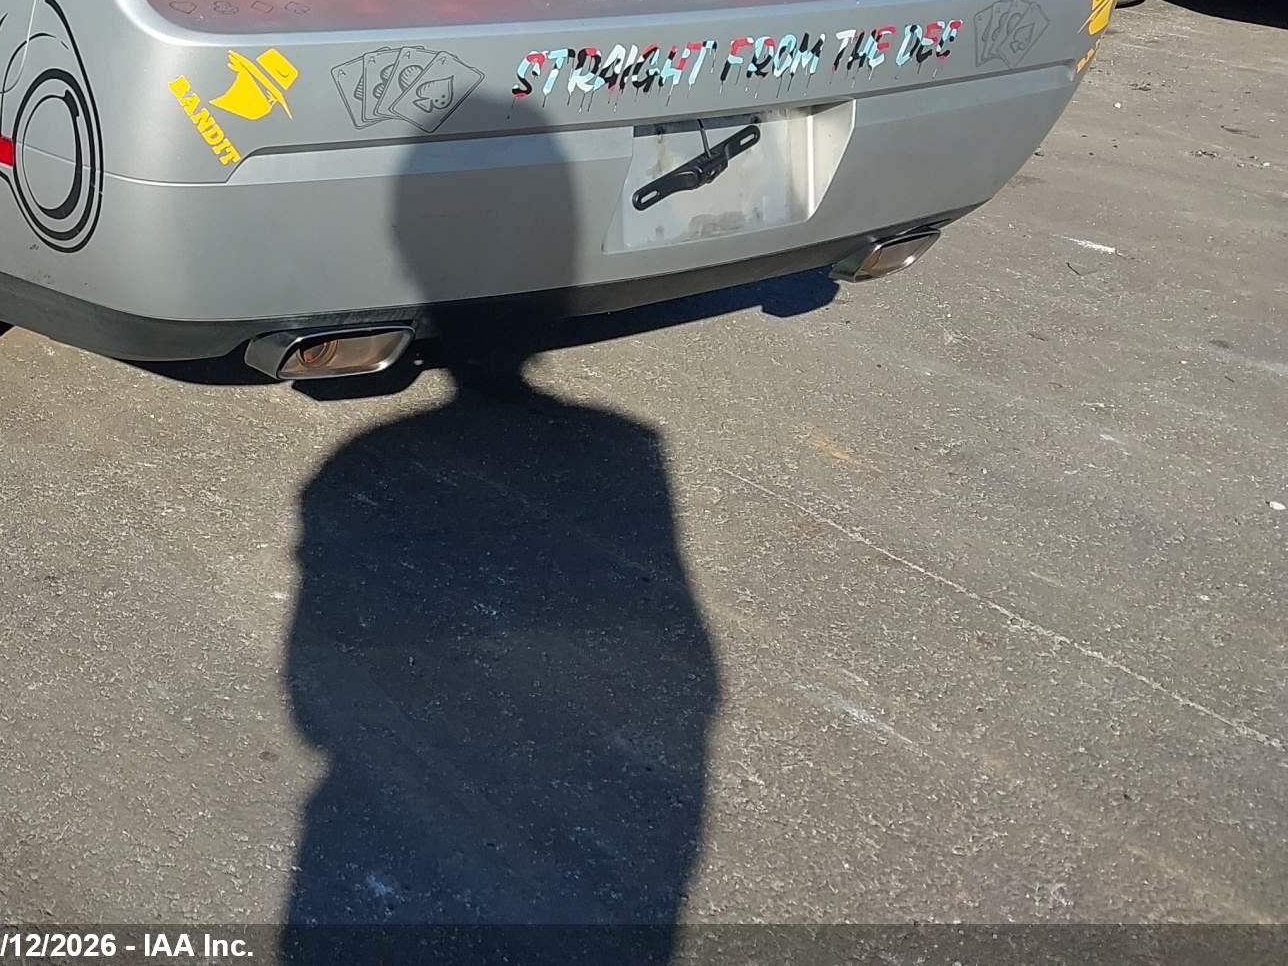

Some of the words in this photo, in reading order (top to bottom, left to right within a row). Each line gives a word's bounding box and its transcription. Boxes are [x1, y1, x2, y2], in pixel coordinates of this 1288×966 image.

[512, 40, 718, 100] STRAIGHT
[720, 33, 826, 82] FROM
[831, 26, 896, 75] THE
[168, 75, 241, 165] BANDIT
